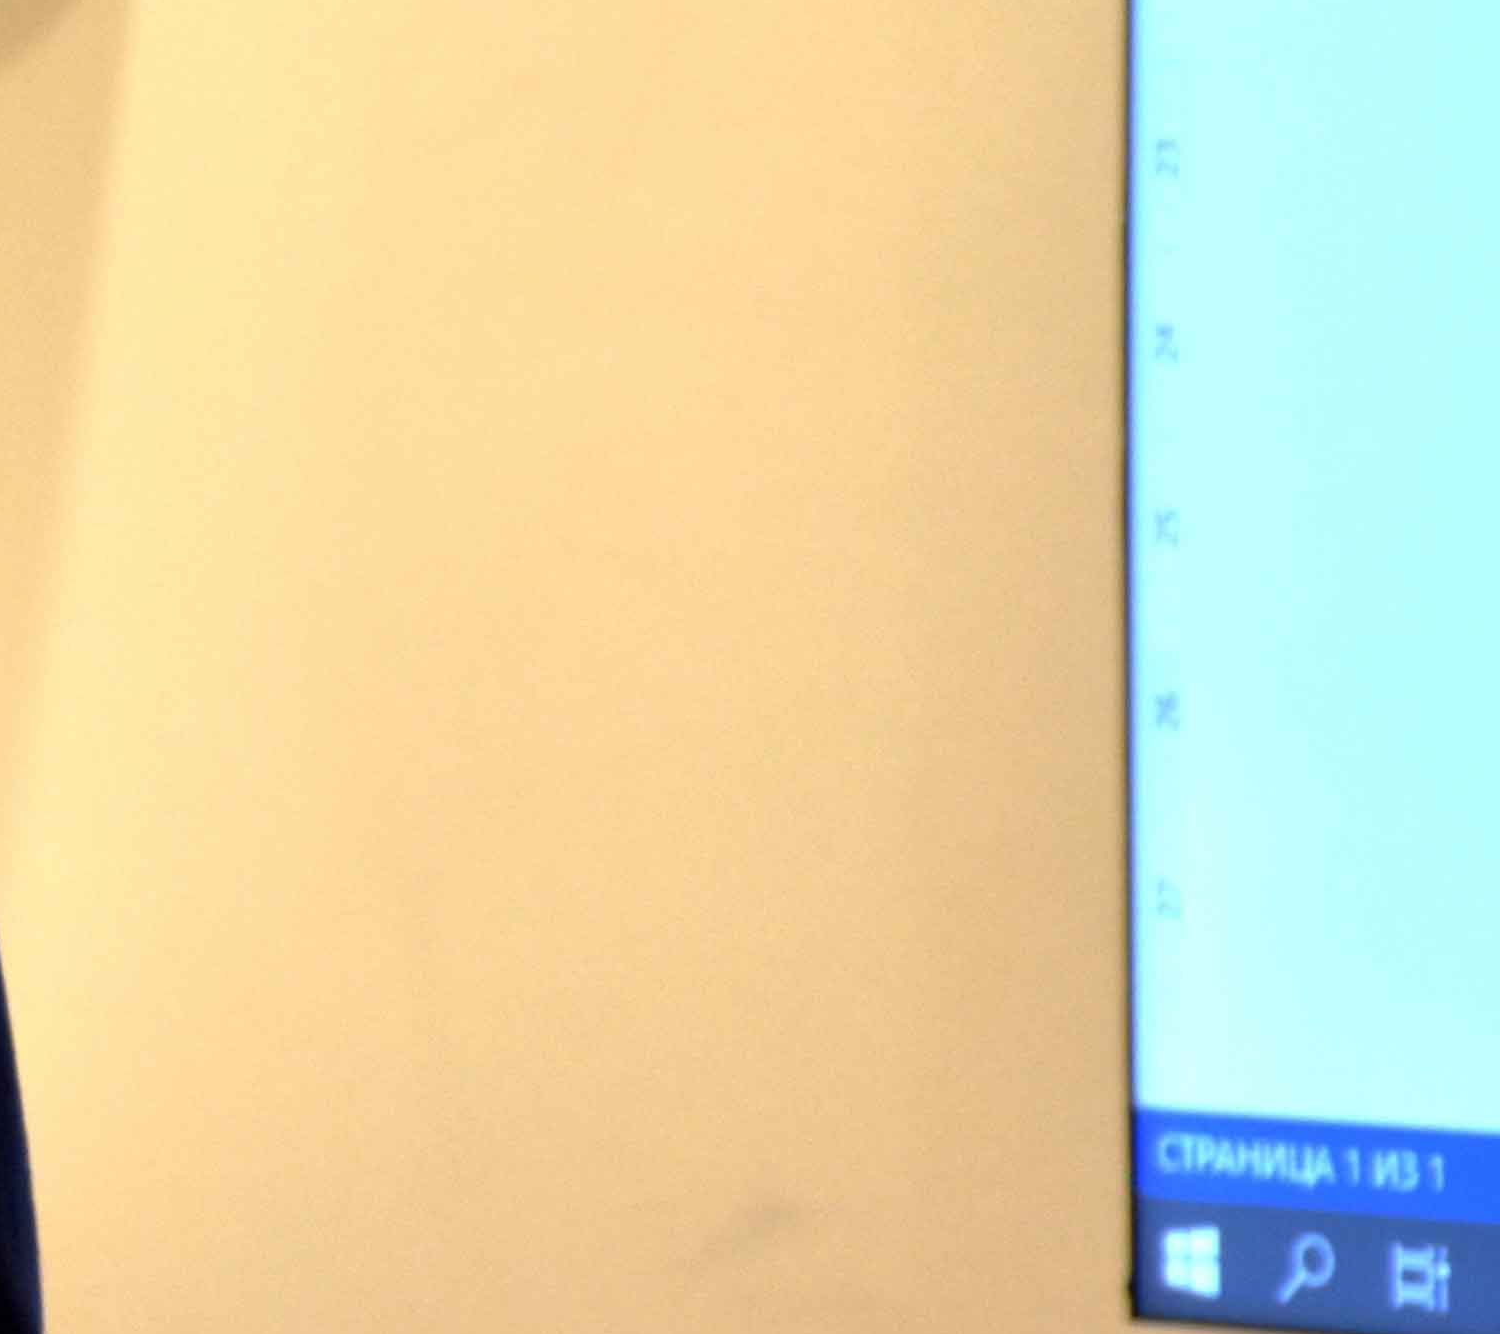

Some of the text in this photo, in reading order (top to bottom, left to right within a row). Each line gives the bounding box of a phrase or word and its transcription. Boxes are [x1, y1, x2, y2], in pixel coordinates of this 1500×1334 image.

[1156, 1131, 1445, 1192] СТРАНИЦА 1 ИЗ 1
